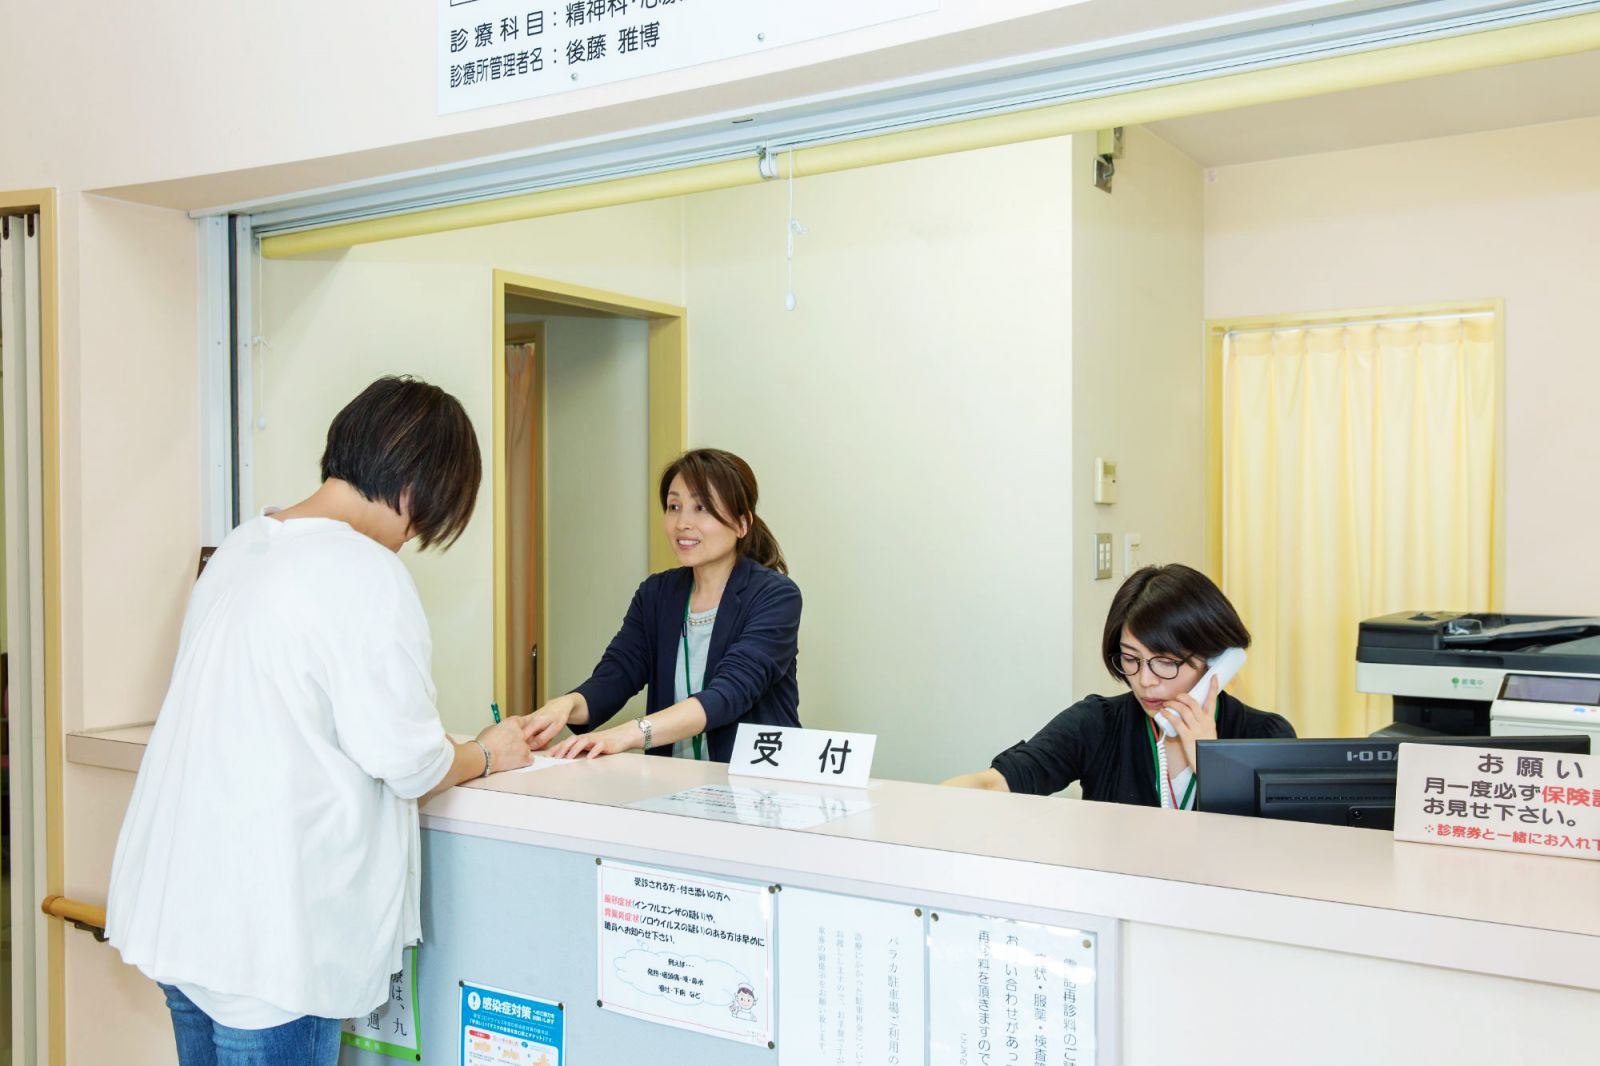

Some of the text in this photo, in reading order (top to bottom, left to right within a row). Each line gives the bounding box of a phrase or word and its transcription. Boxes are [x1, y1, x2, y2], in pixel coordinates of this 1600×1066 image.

[617, 21, 661, 54] 雅博
[749, 731, 852, 775] 受付
[1477, 753, 1584, 780] お願い
[1422, 797, 1578, 828] お見せ下さい。
[482, 997, 532, 1020] 感染症対策
[1005, 934, 1019, 1066] おい合わせがあっ
[1034, 953, 1047, 1066] 状・服薬・検査
